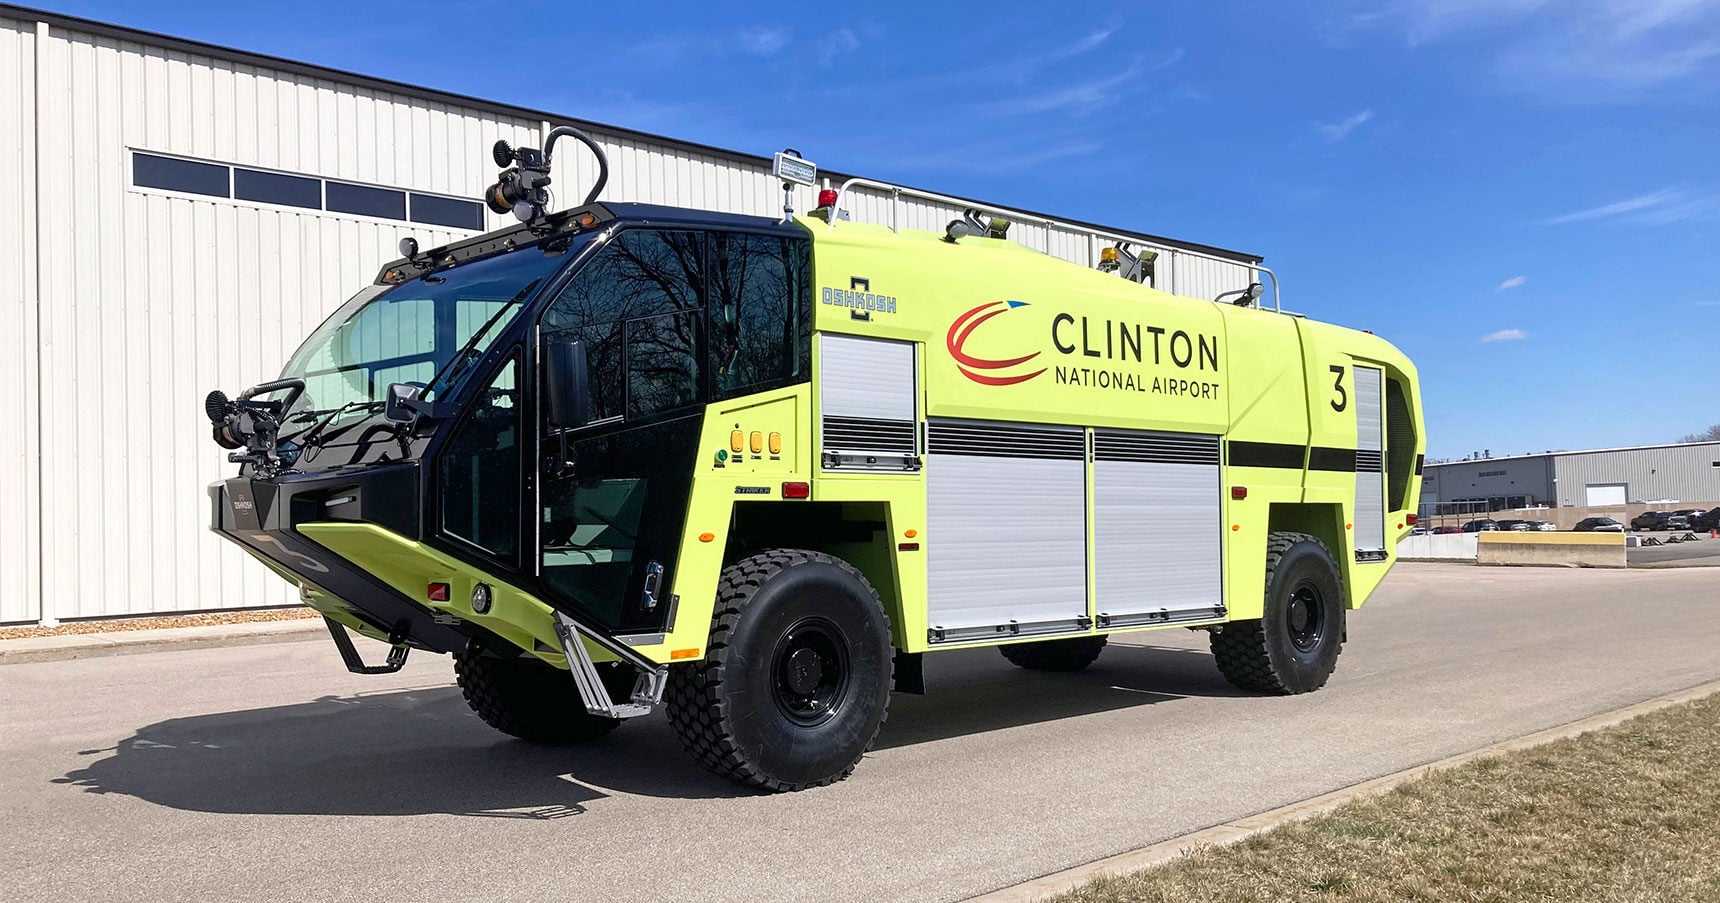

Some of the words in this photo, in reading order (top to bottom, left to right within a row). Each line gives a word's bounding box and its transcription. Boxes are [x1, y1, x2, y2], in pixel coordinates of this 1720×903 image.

[822, 287, 897, 313] OSHKOSH
[1051, 312, 1219, 373] CLINTON
[1055, 366, 1145, 393] NATIONAL
[1151, 377, 1220, 401] AIRPORT
[1329, 365, 1347, 412] 3
